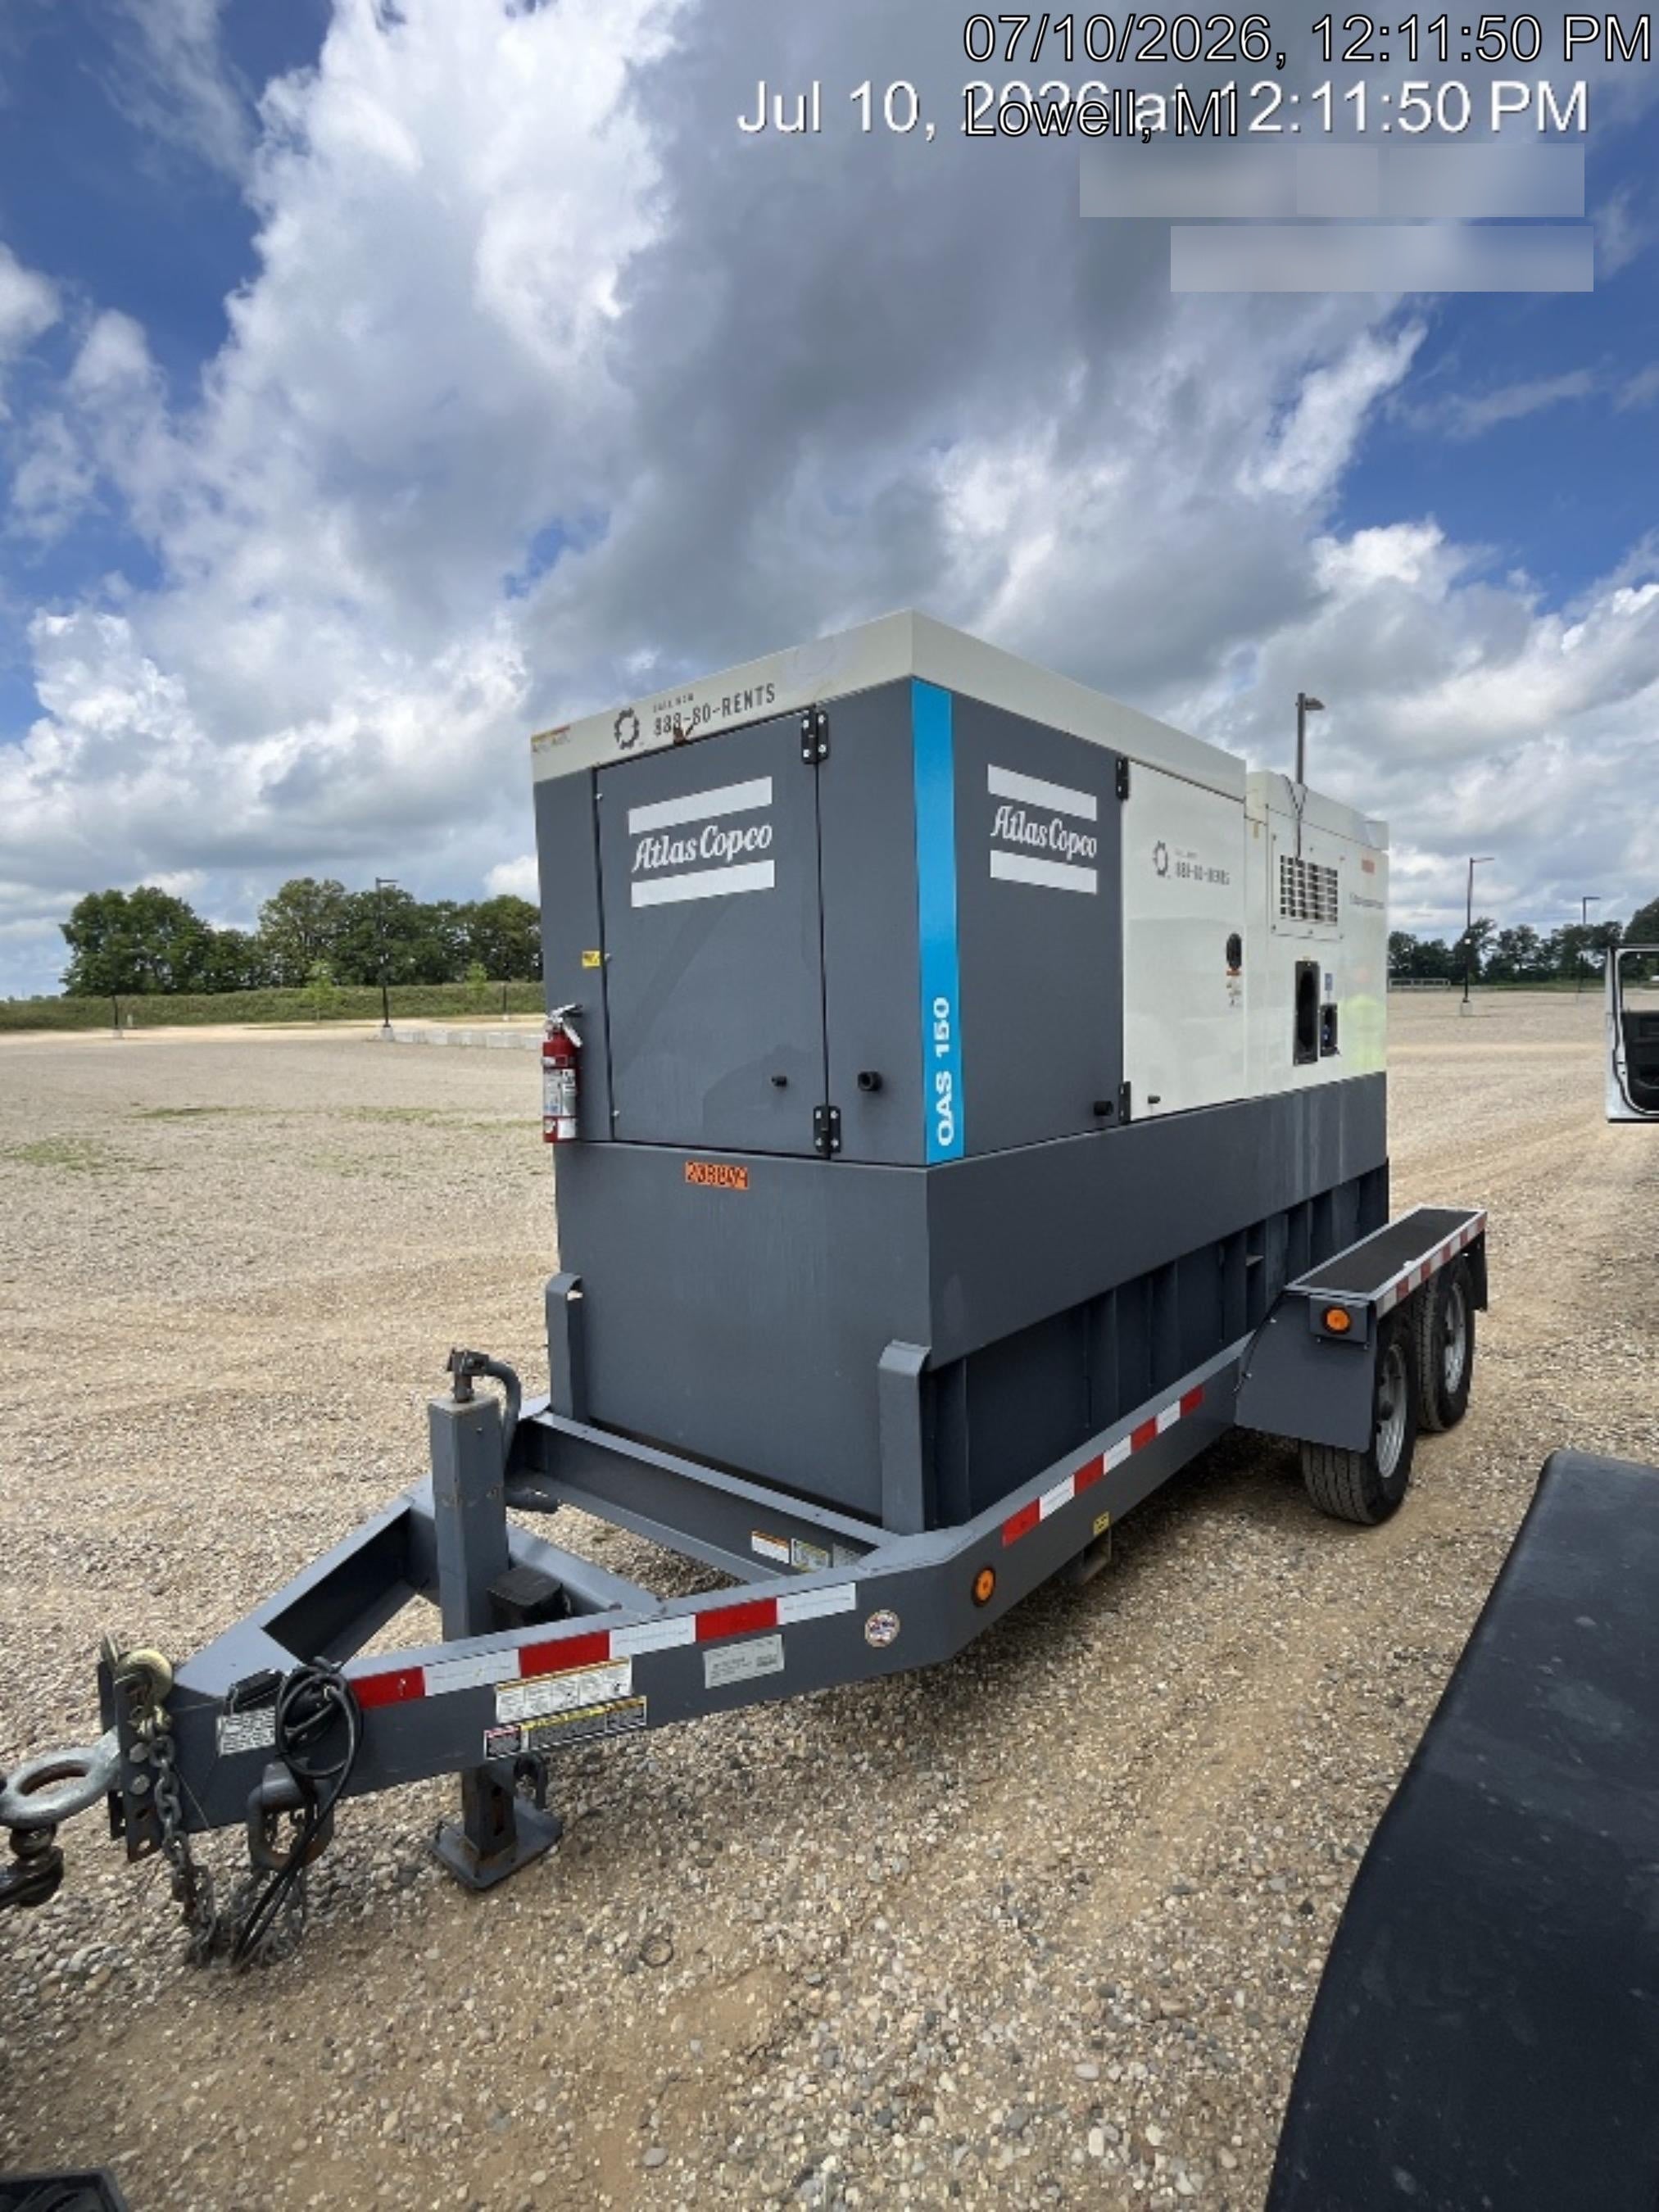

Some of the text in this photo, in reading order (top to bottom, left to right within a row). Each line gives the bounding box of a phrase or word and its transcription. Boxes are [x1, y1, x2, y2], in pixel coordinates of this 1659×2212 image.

[631, 825, 773, 874] Atlas Copco
[990, 805, 1098, 861] Atlas Copco
[932, 996, 950, 1058] 150
